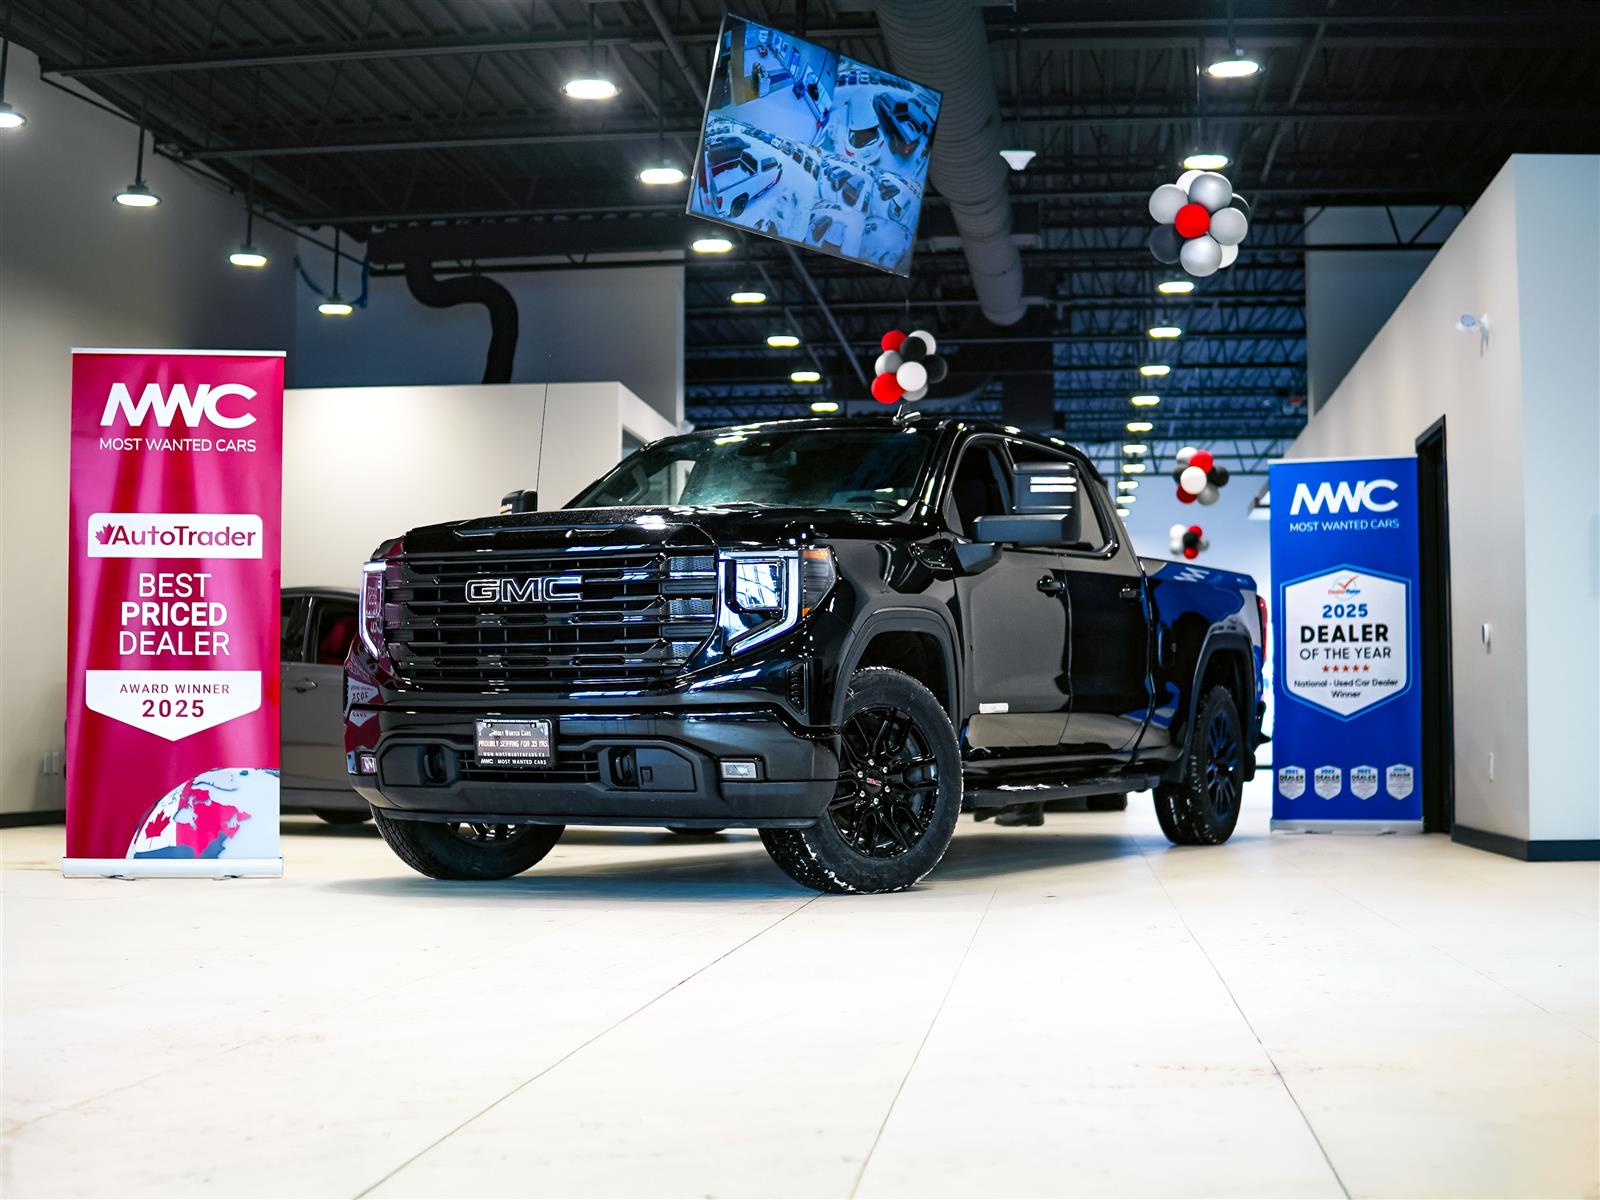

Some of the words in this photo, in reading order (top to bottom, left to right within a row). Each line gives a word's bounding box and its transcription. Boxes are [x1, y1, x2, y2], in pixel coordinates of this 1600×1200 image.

[100, 382, 257, 429] MWC
[99, 438, 142, 451] MOST
[145, 438, 212, 452] WANTED
[215, 439, 257, 452] CARS
[1290, 479, 1399, 515] MWC
[1290, 521, 1319, 532] MOST
[1321, 519, 1368, 531] WANTED
[1370, 518, 1400, 530] CARS
[112, 525, 257, 547] AutoTrader
[138, 573, 212, 598] BEST
[465, 575, 583, 603] GMC
[121, 602, 229, 627] PRICED
[1322, 604, 1369, 619] 2025
[1300, 624, 1389, 643] DEALER
[119, 631, 231, 656] DEALER
[1299, 648, 1319, 660] OF
[1323, 648, 1350, 660] THE
[1354, 646, 1392, 660] YEAR
[119, 683, 170, 695] AWARD
[174, 683, 230, 695] WINNER
[1333, 679, 1354, 687] Used
[1355, 679, 1370, 687] Car
[1331, 690, 1361, 698] Winner
[142, 700, 205, 718] 2025
